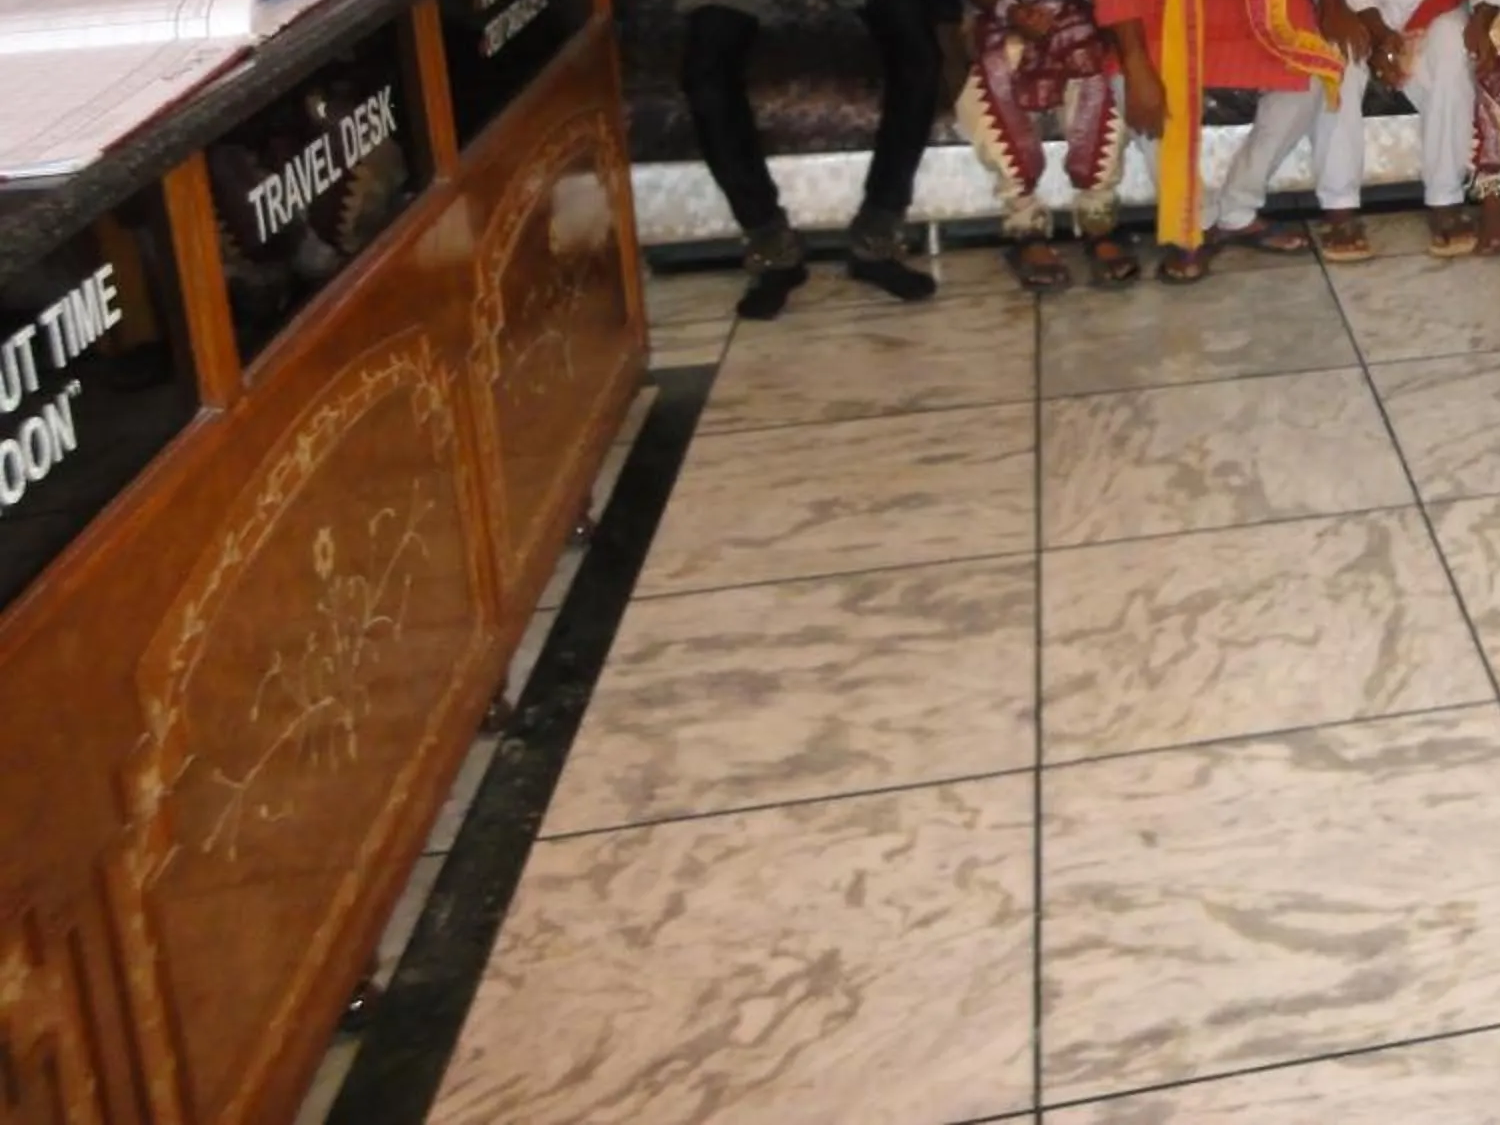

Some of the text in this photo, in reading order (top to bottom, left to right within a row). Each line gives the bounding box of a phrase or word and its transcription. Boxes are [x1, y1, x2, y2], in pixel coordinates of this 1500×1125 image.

[248, 85, 397, 243] TRAVEL DESK
[39, 262, 123, 369] TIME
